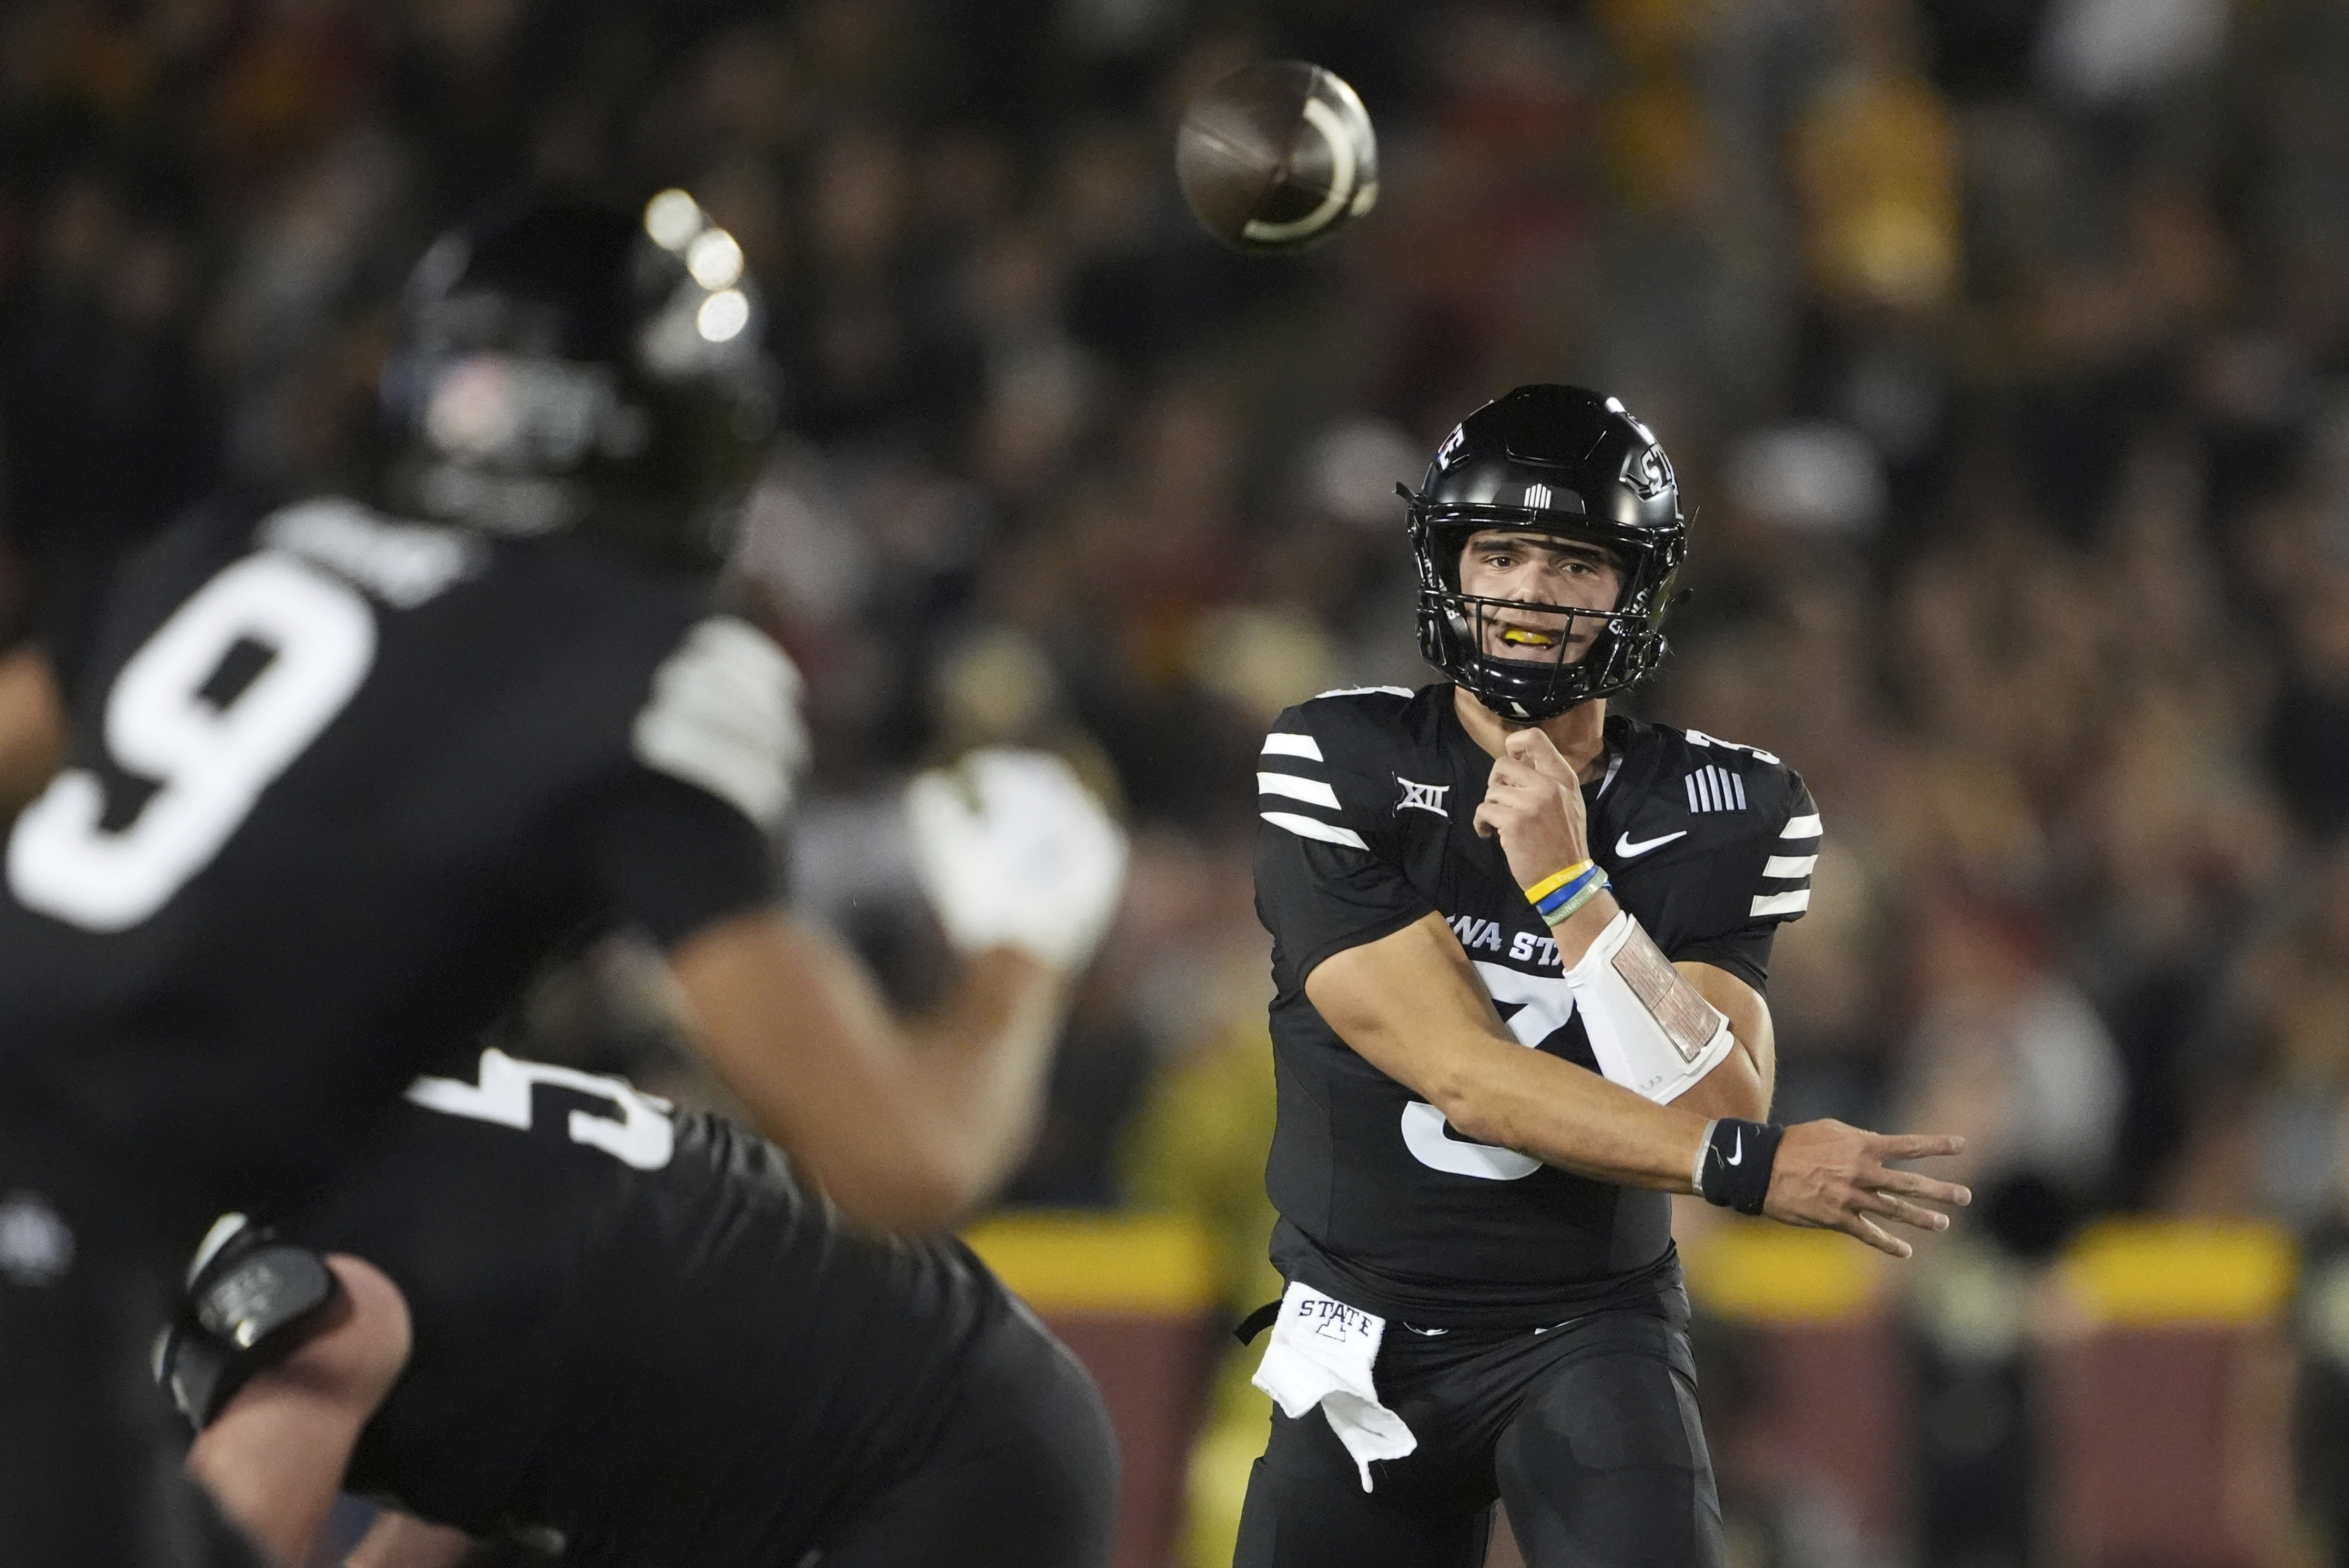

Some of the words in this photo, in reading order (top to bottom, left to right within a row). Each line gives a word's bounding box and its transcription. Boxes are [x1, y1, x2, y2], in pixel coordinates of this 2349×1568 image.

[6, 551, 379, 934] 9
[1397, 777, 1449, 817] XII
[1299, 1300, 1372, 1337] STATE
